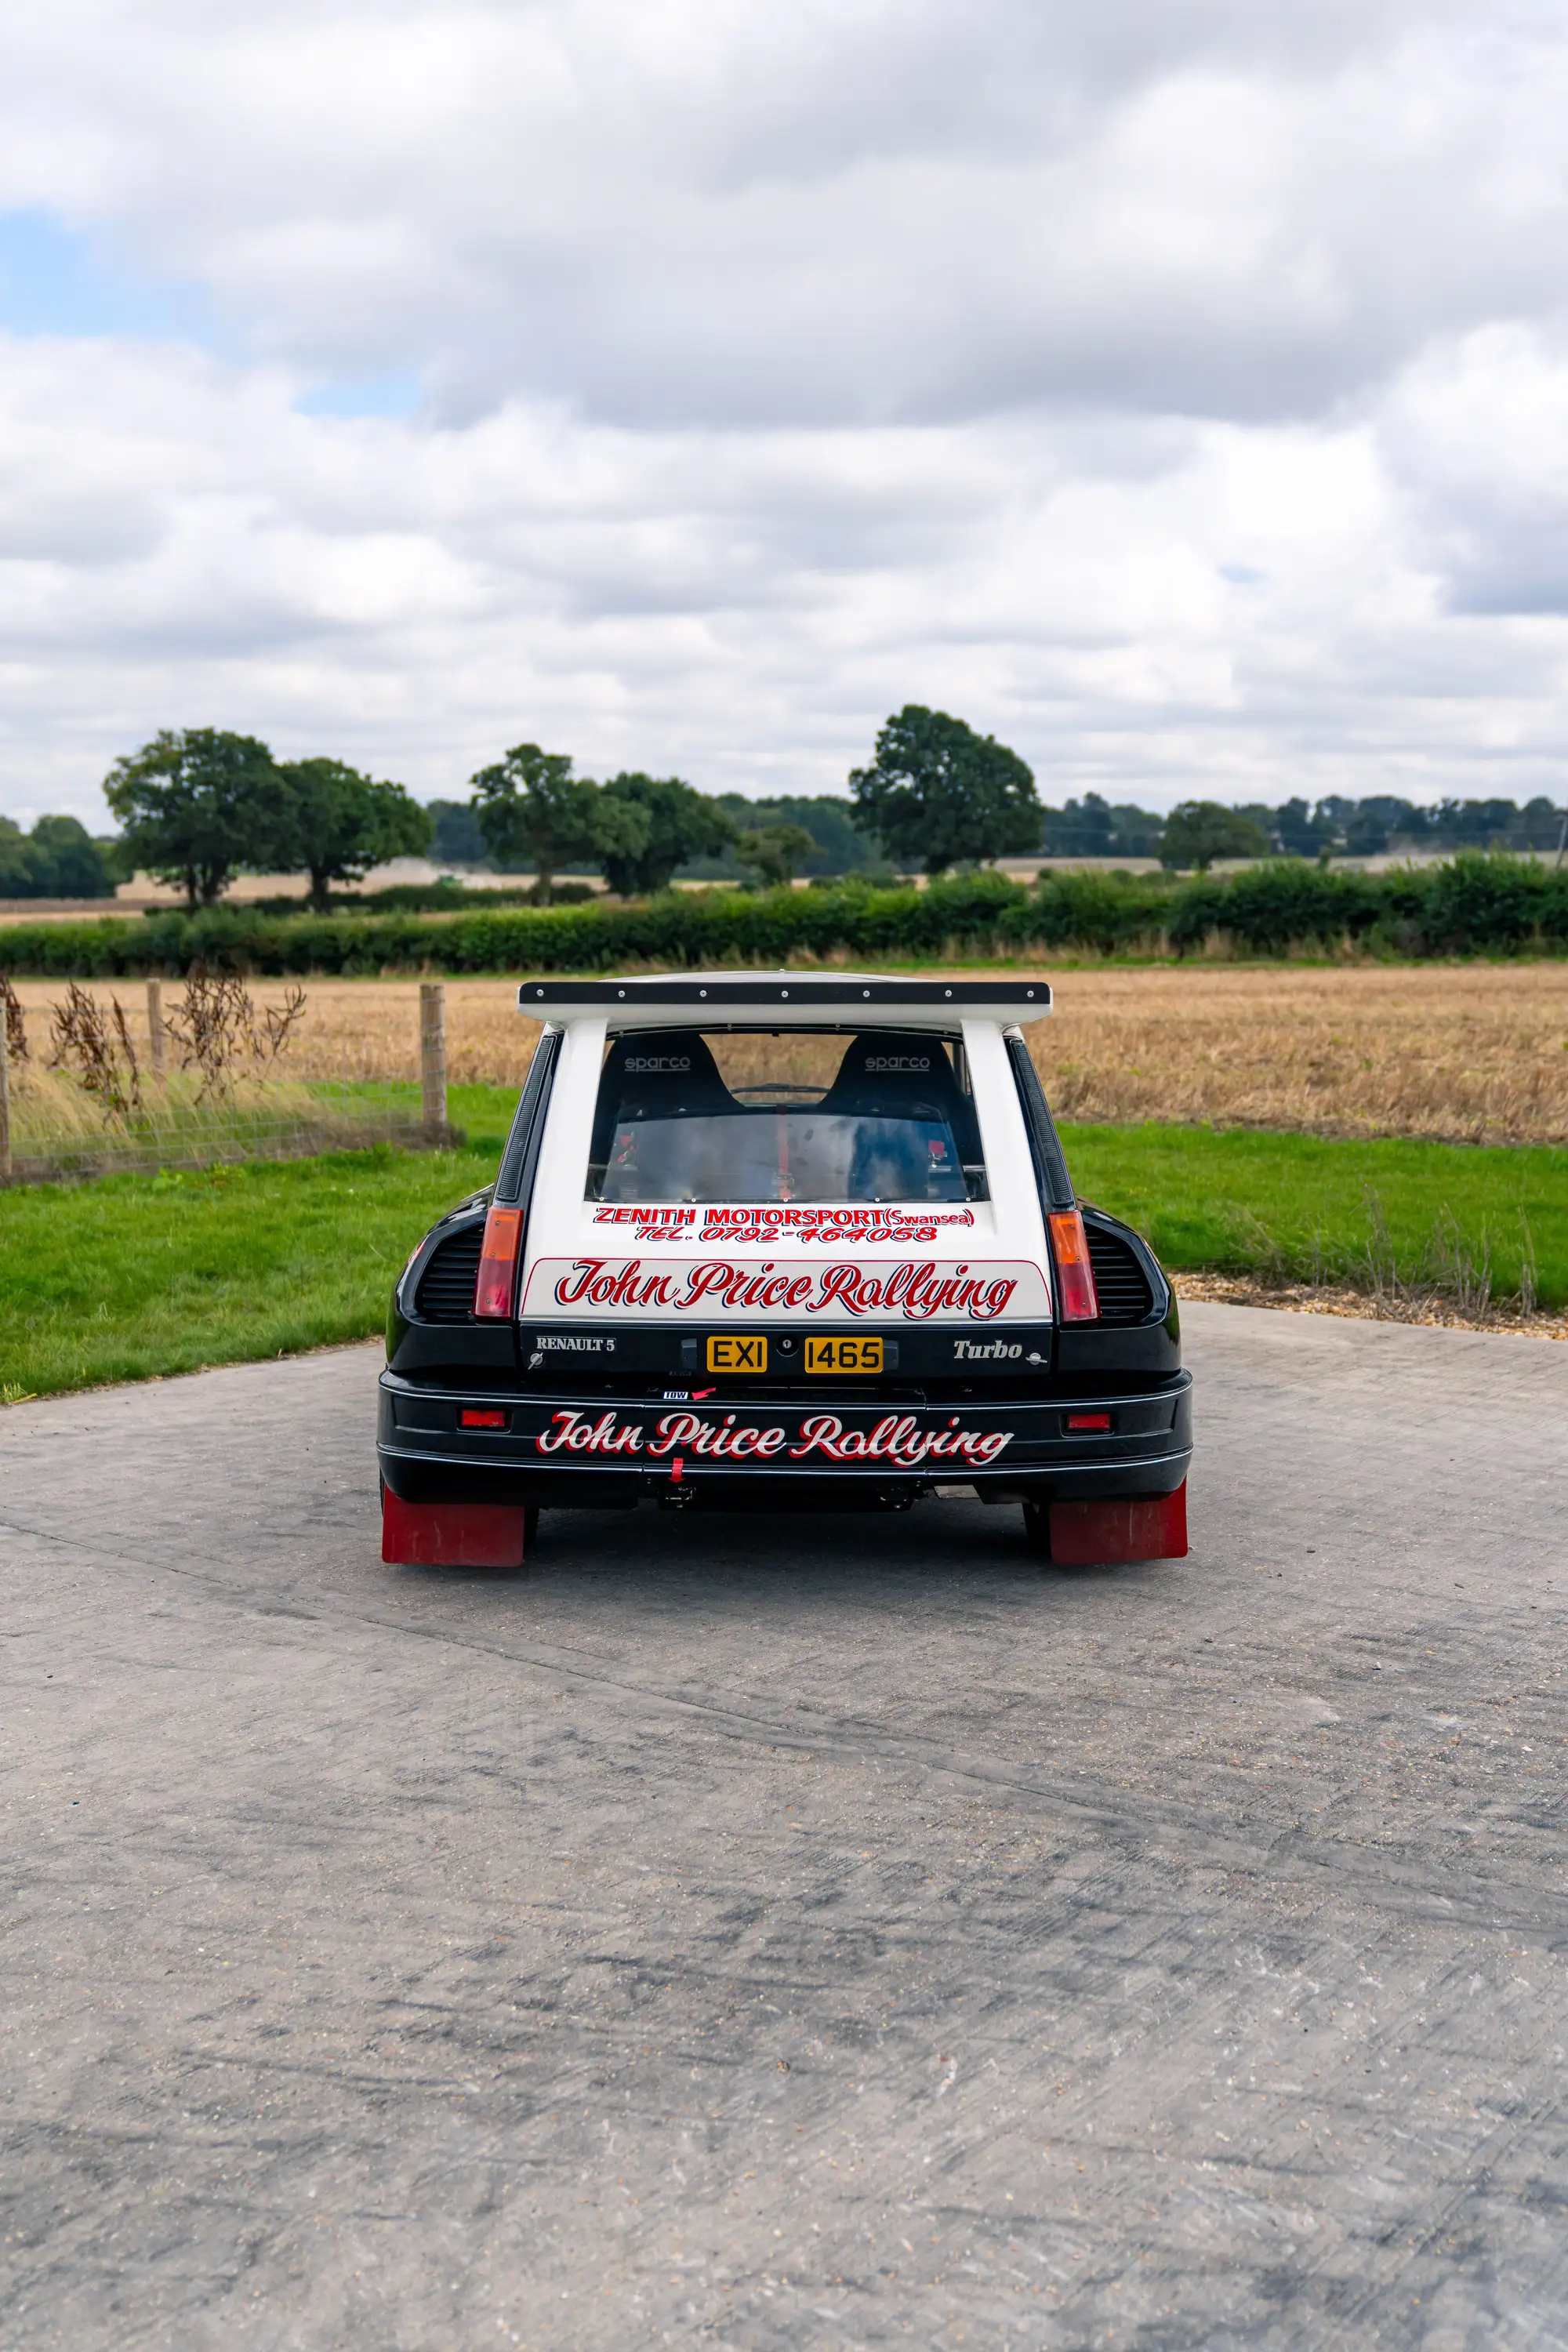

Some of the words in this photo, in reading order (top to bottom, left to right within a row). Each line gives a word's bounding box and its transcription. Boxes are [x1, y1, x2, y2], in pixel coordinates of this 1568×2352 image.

[624, 1056, 691, 1073] sparco
[865, 1056, 931, 1072] sparco
[593, 1207, 697, 1225] ZENITH
[634, 1226, 694, 1241] TEL.
[698, 1226, 938, 1243] 0792-464058
[554, 1259, 681, 1307] John
[673, 1261, 814, 1309] Price
[804, 1262, 1018, 1321] Rallying
[536, 1337, 604, 1351] RENAULT
[606, 1339, 615, 1352] 5
[953, 1339, 1022, 1359] Turbo
[808, 1341, 880, 1368] 1465
[666, 1391, 687, 1399] TOW
[535, 1410, 644, 1454] John
[647, 1412, 786, 1459] Price
[788, 1414, 1014, 1468] Rallying
